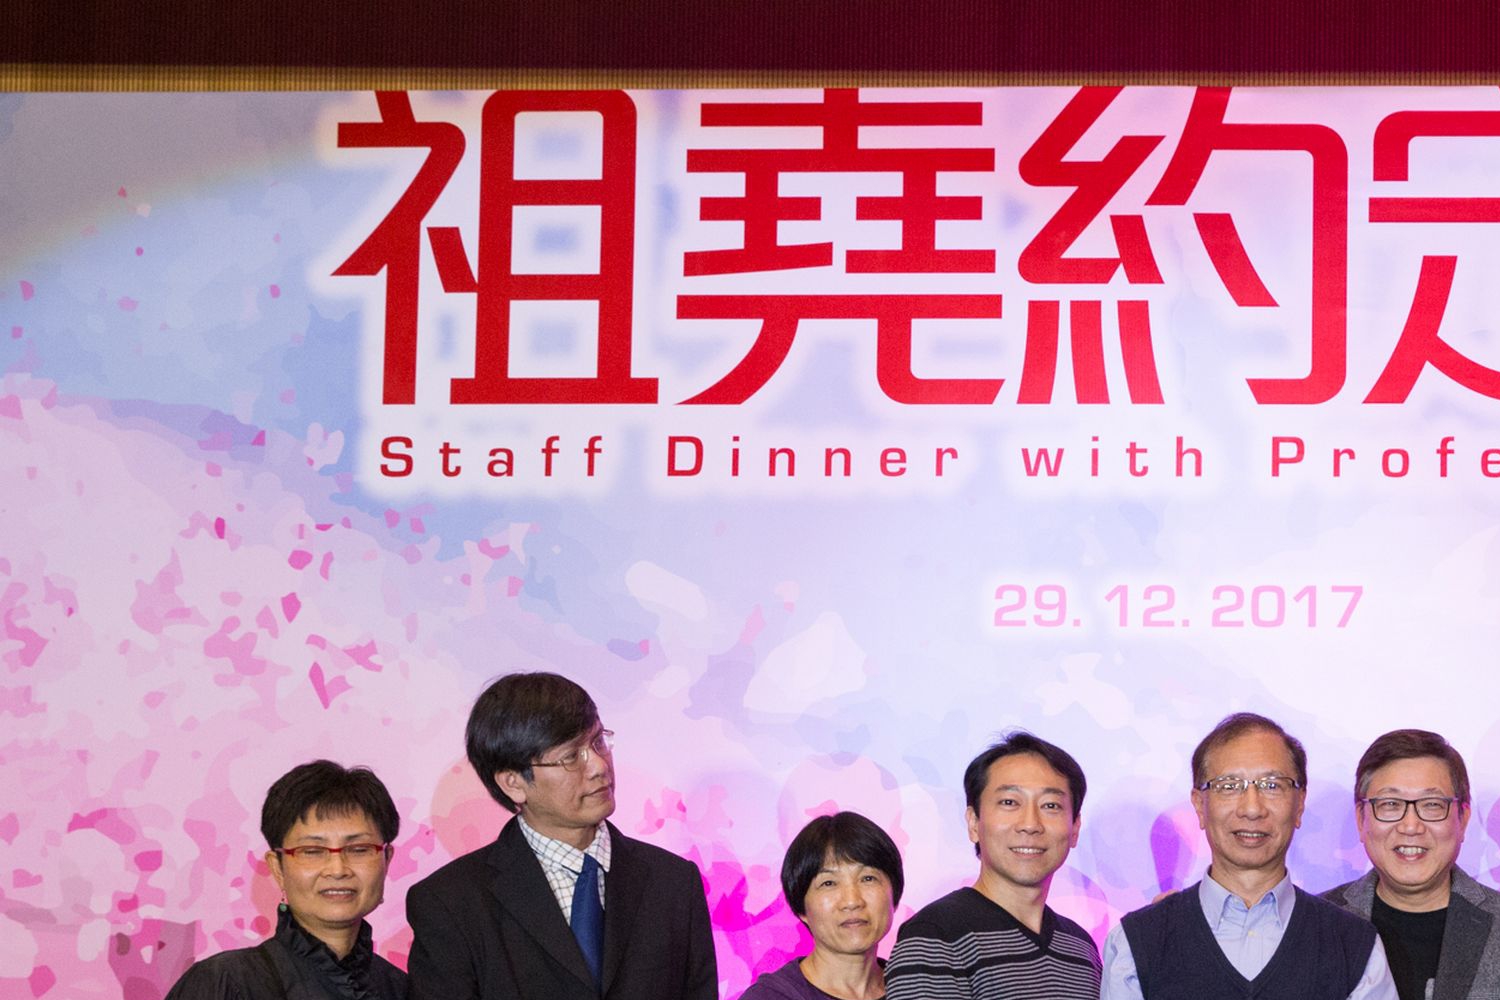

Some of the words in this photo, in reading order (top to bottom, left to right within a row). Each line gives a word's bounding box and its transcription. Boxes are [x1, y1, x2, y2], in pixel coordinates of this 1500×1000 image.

[380, 435, 604, 478] Staff
[667, 435, 960, 478] Dinner
[1021, 435, 1205, 478] with
[994, 584, 1082, 629] 29.
[1103, 584, 1190, 629] 12.
[1211, 584, 1364, 629] 2017
